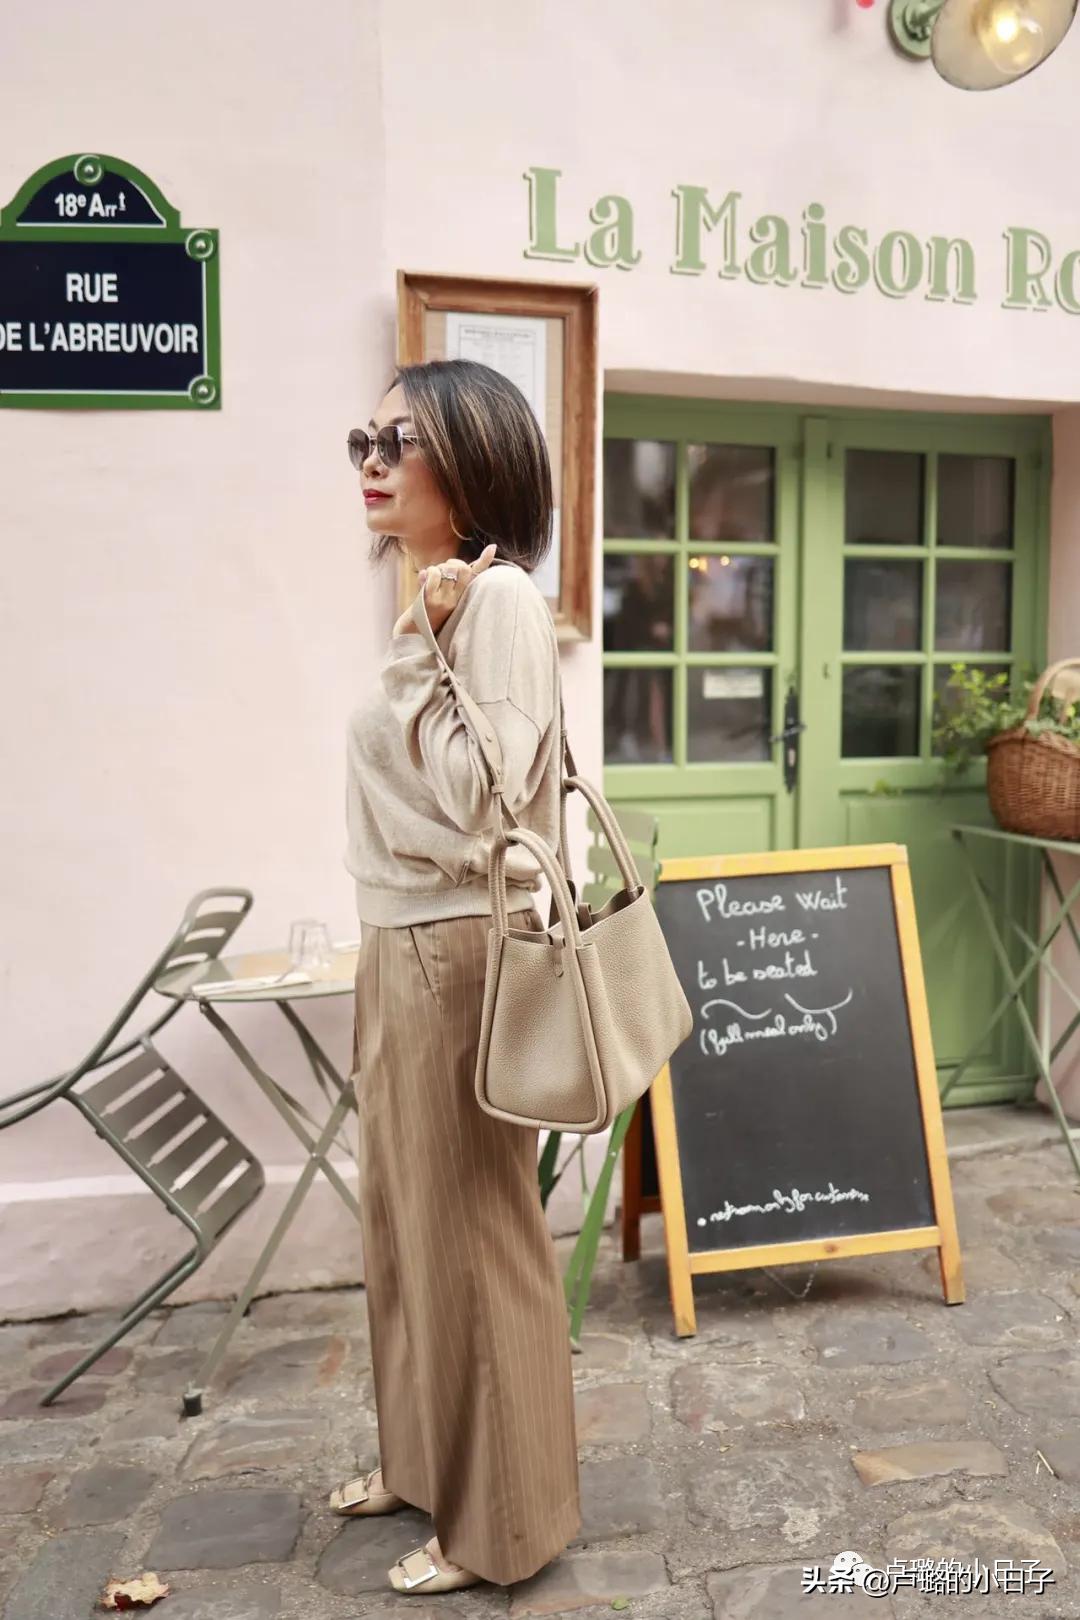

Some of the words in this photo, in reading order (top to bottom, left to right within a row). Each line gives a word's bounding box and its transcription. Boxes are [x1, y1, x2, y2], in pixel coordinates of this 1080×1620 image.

[523, 166, 642, 271] La
[670, 184, 979, 303] Maison
[66, 273, 118, 303] RUE
[29, 323, 199, 353] L'ABREUVOIR
[696, 883, 786, 922] Please
[795, 876, 848, 911] Wait
[697, 959, 717, 990] to
[722, 957, 748, 985] be
[752, 949, 818, 981] seated
[744, 1013, 786, 1040] meal
